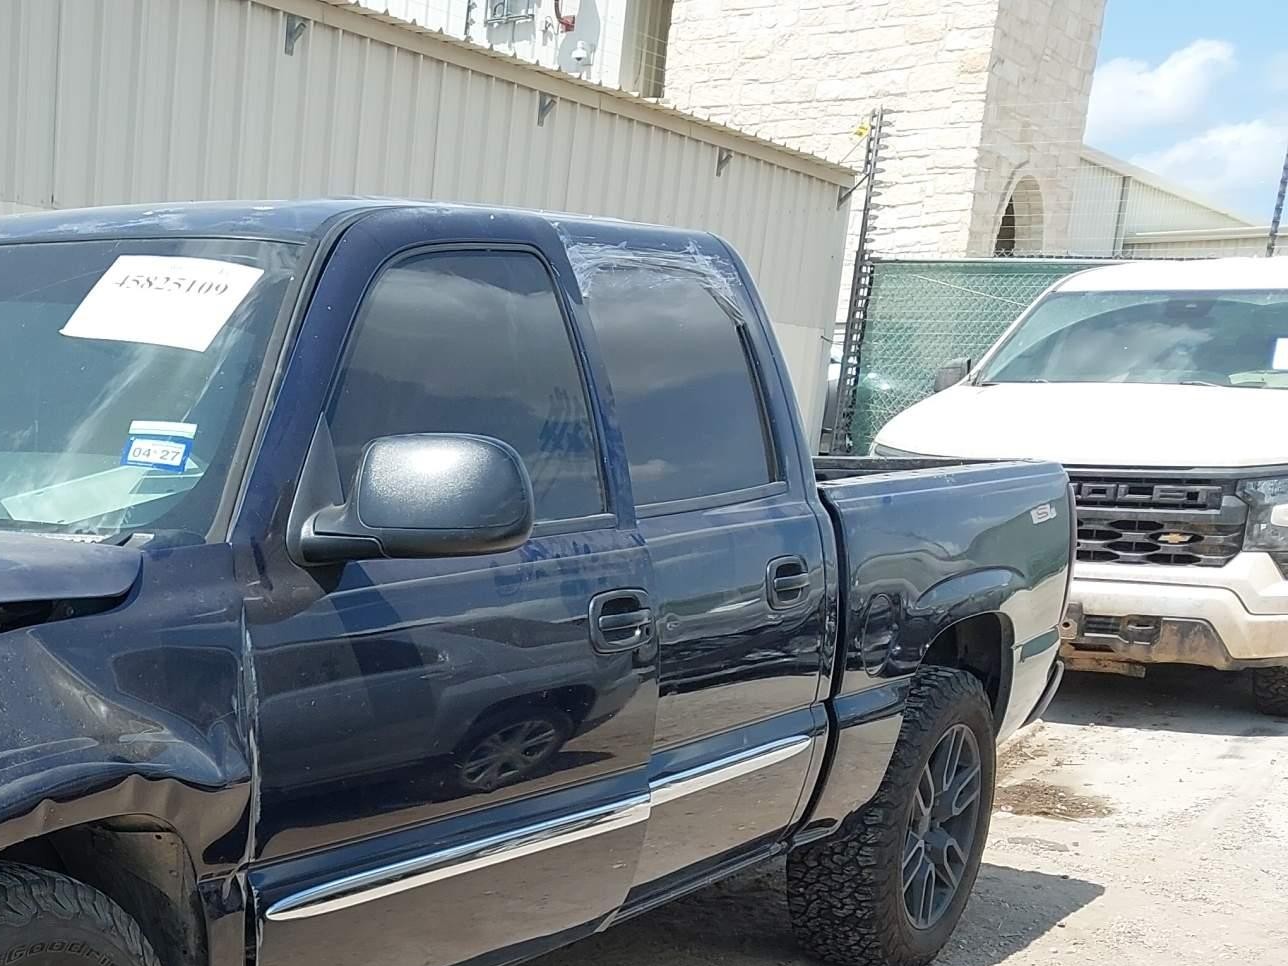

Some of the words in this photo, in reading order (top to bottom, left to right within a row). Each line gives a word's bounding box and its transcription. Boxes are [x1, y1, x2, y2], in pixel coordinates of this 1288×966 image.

[112, 274, 230, 296] 45825109
[132, 447, 152, 459] 04
[159, 449, 181, 462] 27
